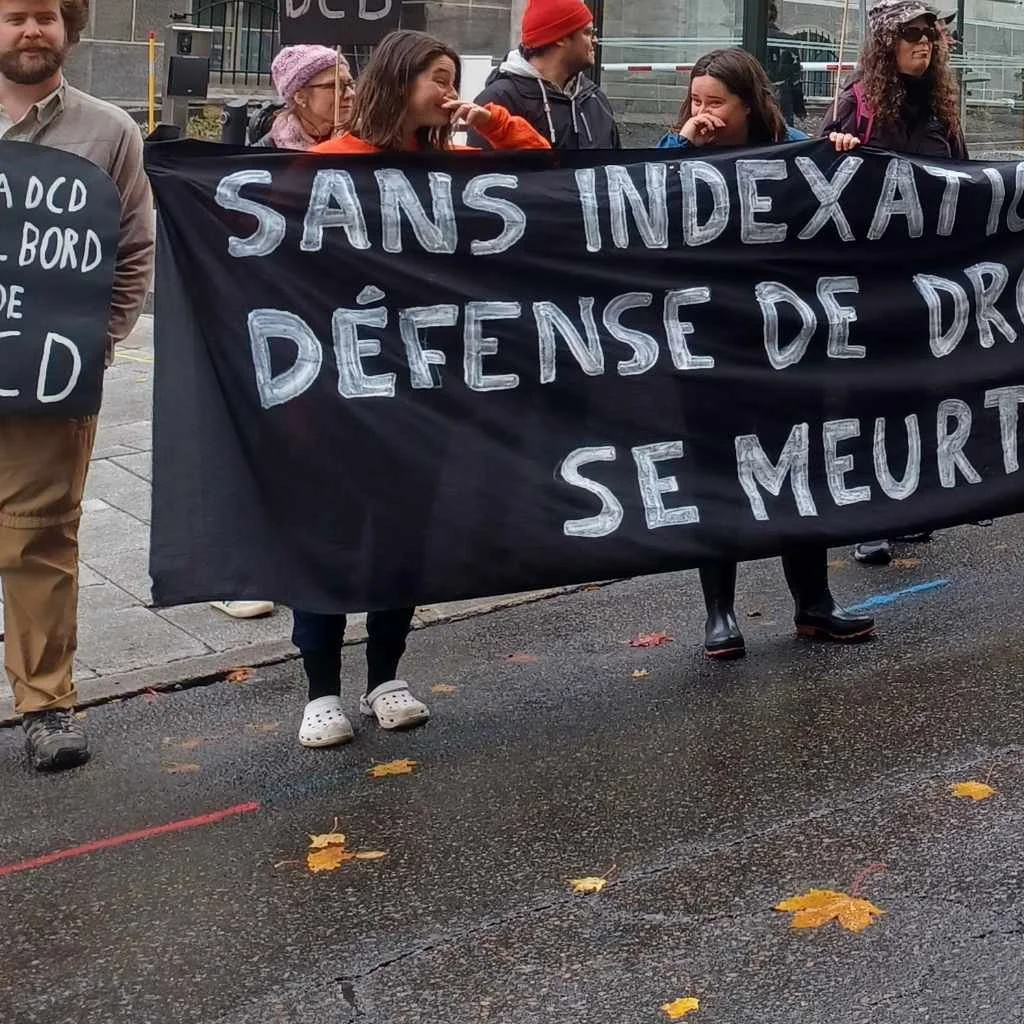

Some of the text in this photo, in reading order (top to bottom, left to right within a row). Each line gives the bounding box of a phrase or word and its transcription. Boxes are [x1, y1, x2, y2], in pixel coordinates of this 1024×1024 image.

[25, 175, 87, 214] DCD
[215, 169, 527, 257] SANS
[18, 221, 102, 273] BORD
[247, 285, 716, 409] DÉFENSE
[755, 276, 867, 370] DE
[561, 440, 700, 538] SE
